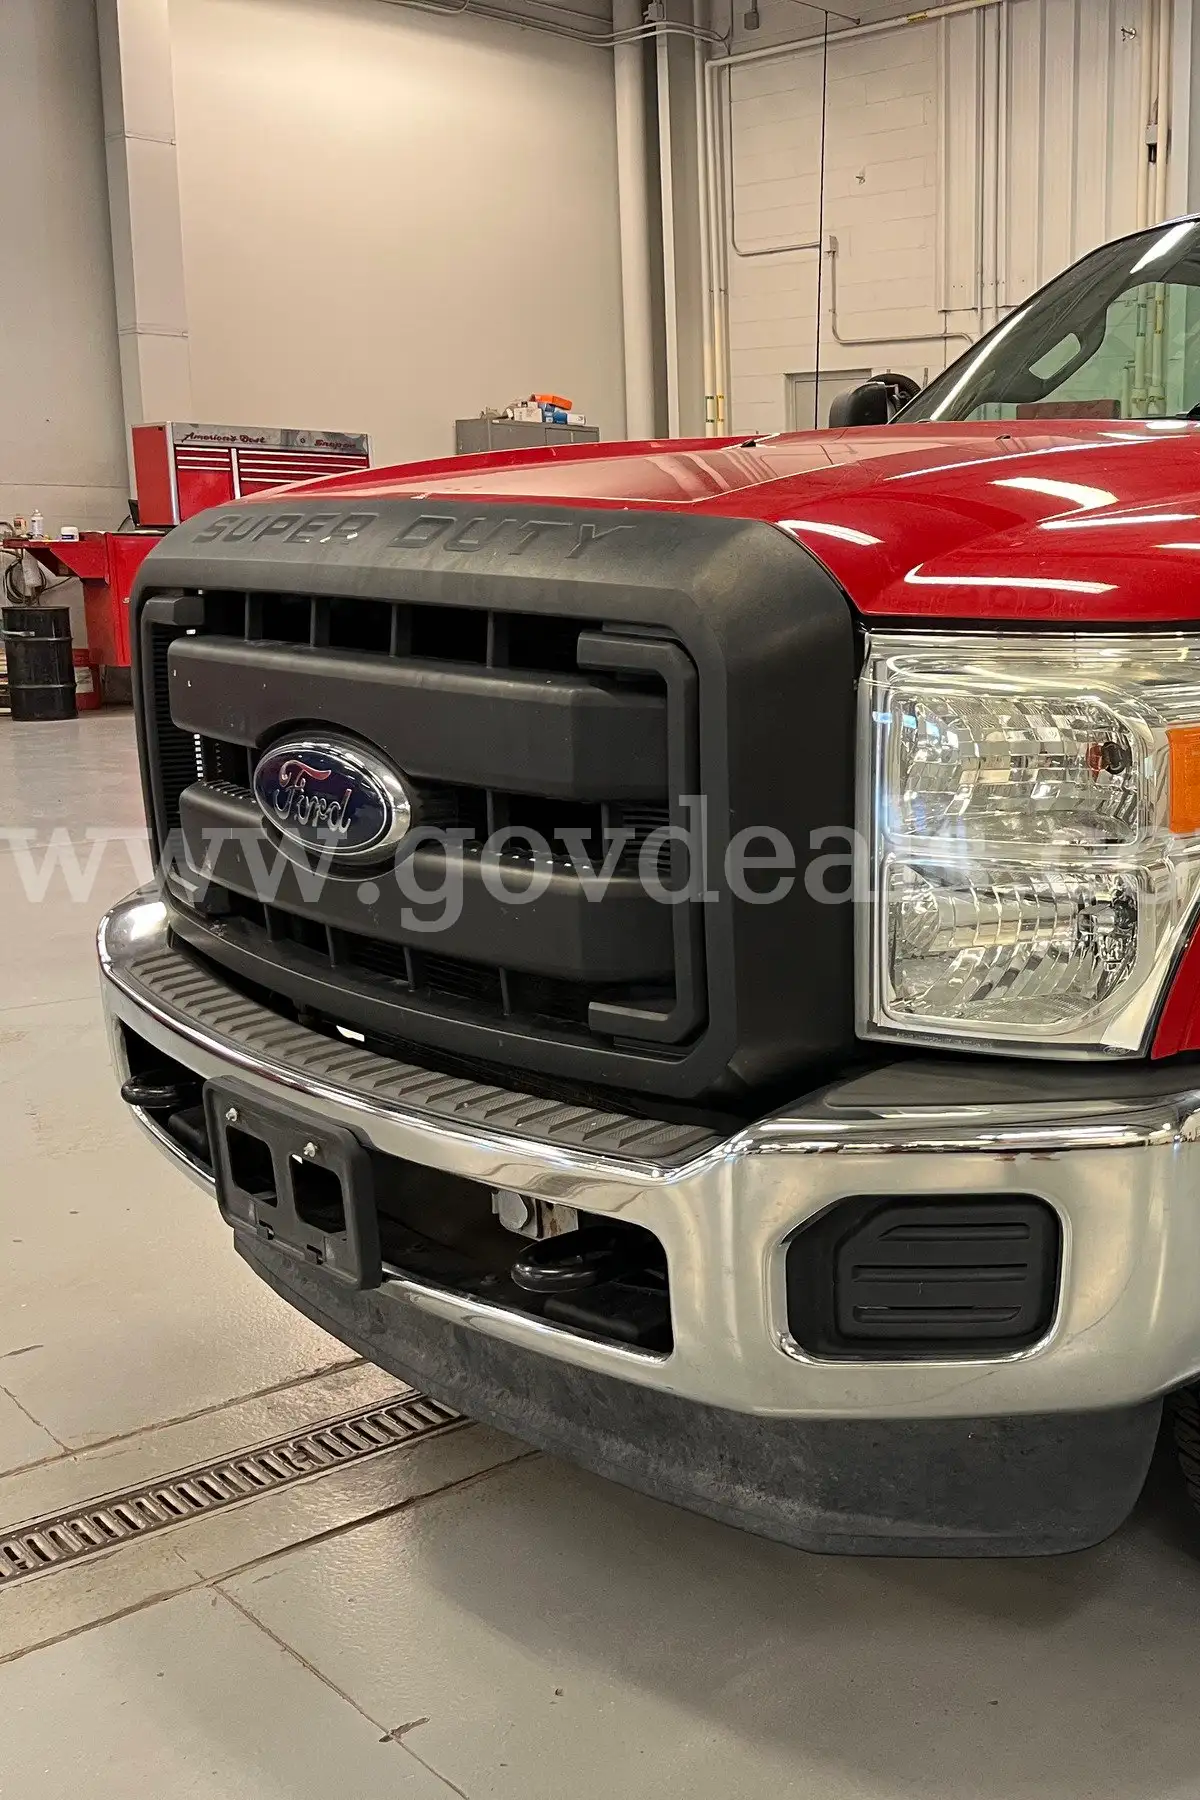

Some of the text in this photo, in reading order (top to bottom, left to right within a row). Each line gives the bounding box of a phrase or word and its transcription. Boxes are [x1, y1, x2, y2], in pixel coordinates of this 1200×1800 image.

[192, 512, 637, 559] SUPER DUTY
[273, 759, 353, 834] Ford
